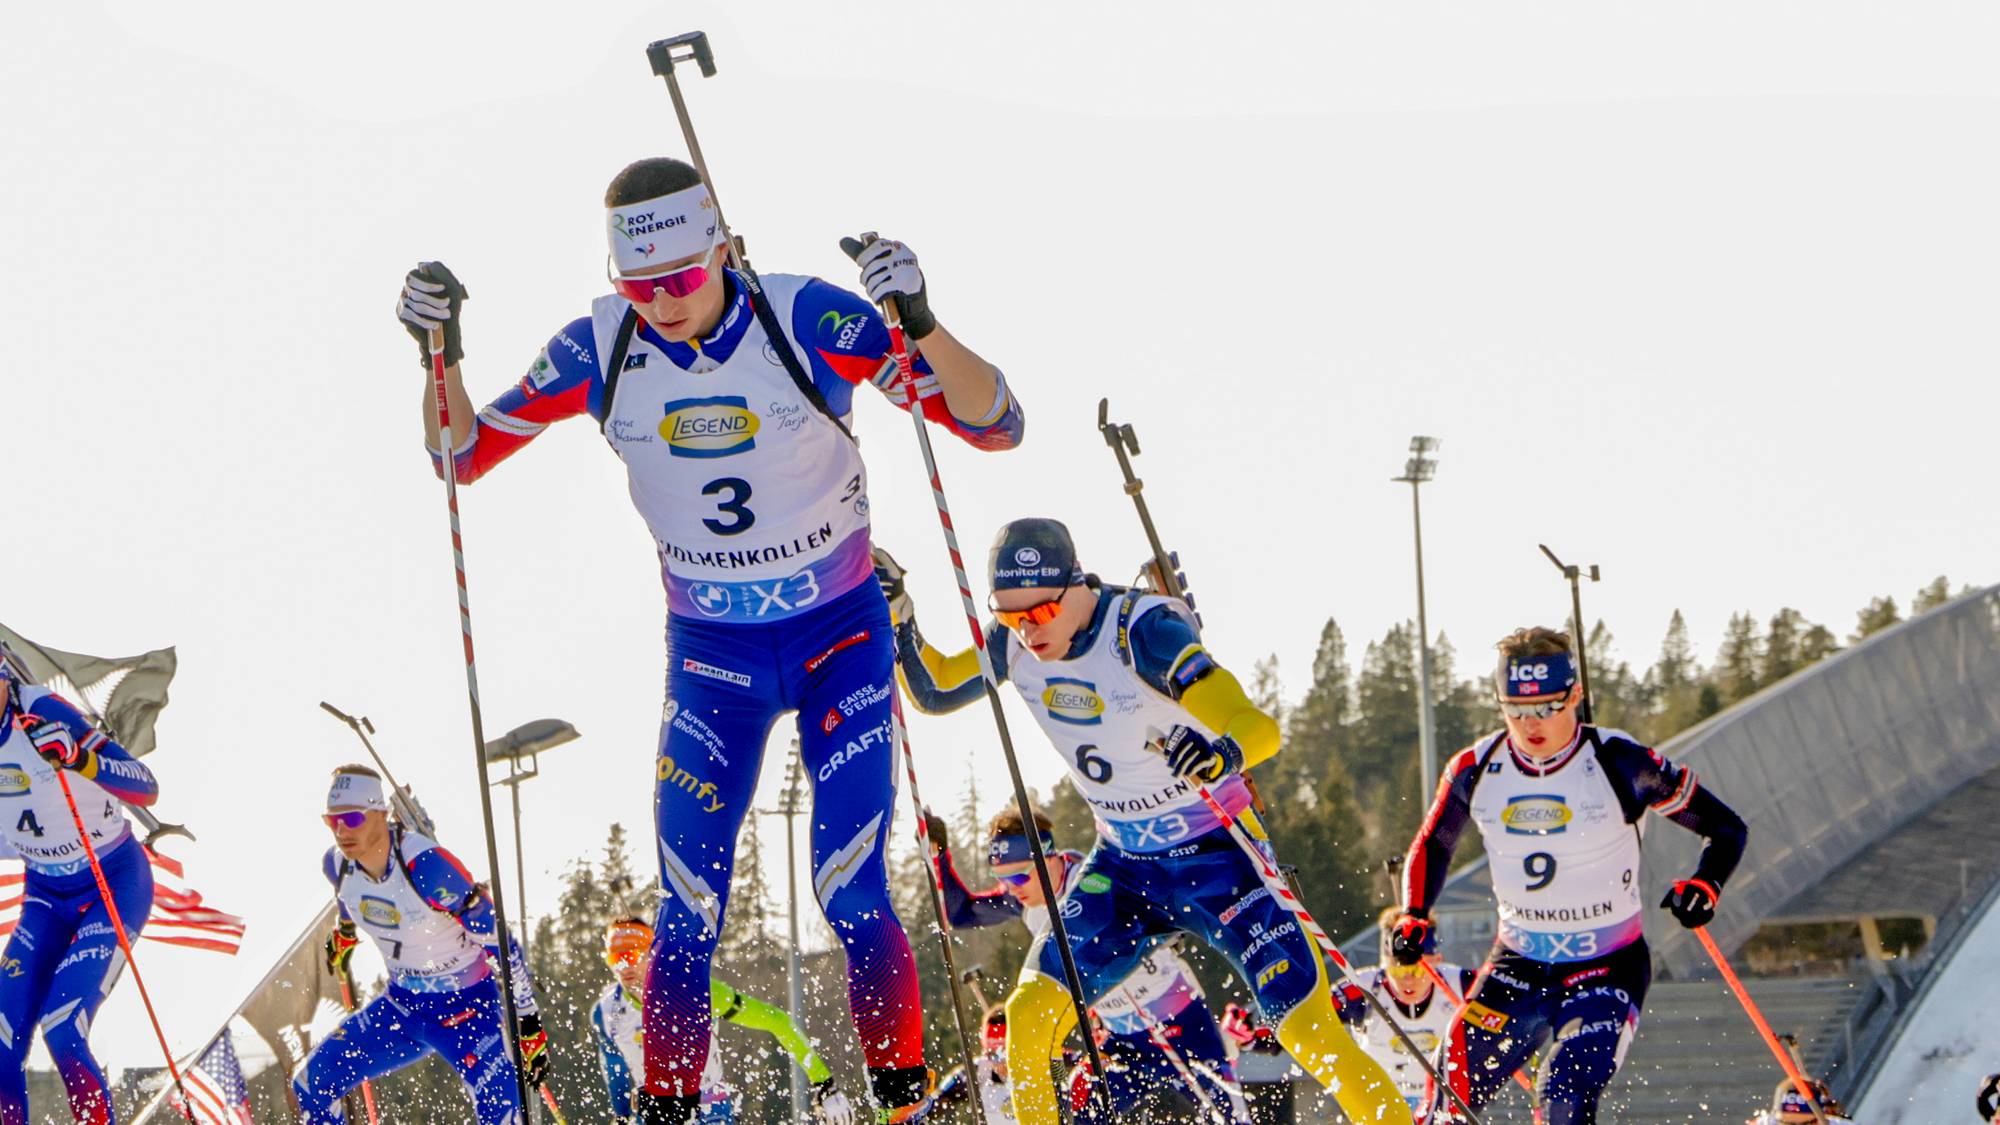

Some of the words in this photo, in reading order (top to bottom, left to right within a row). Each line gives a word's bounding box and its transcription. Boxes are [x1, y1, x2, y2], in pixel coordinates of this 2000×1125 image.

[627, 212, 655, 226] ROY
[629, 215, 687, 237] ENERGIE
[836, 320, 857, 349] ROY
[671, 415, 750, 441] LEGEND
[840, 473, 861, 503] 3
[701, 477, 756, 536] 3
[995, 567, 1040, 578] Monitor
[1041, 567, 1061, 577] ERP
[752, 569, 820, 616] X3
[1510, 659, 1549, 681] ice
[838, 683, 877, 709] CAISSE
[1049, 689, 1098, 710] LEGEND
[673, 717, 729, 767] Rhône-Alpes
[680, 708, 726, 749] Auvergne-
[818, 725, 884, 782] CRAFT
[1075, 744, 1112, 784] 6
[657, 755, 726, 813] omfy
[16, 808, 44, 837] 4
[103, 799, 114, 818] 4
[1509, 805, 1565, 824] LEGEND
[1131, 813, 1190, 848] X3
[1523, 852, 1557, 892] 9
[1622, 868, 1633, 891] 9
[1547, 931, 1598, 959] X3
[1259, 959, 1291, 987] ATG
